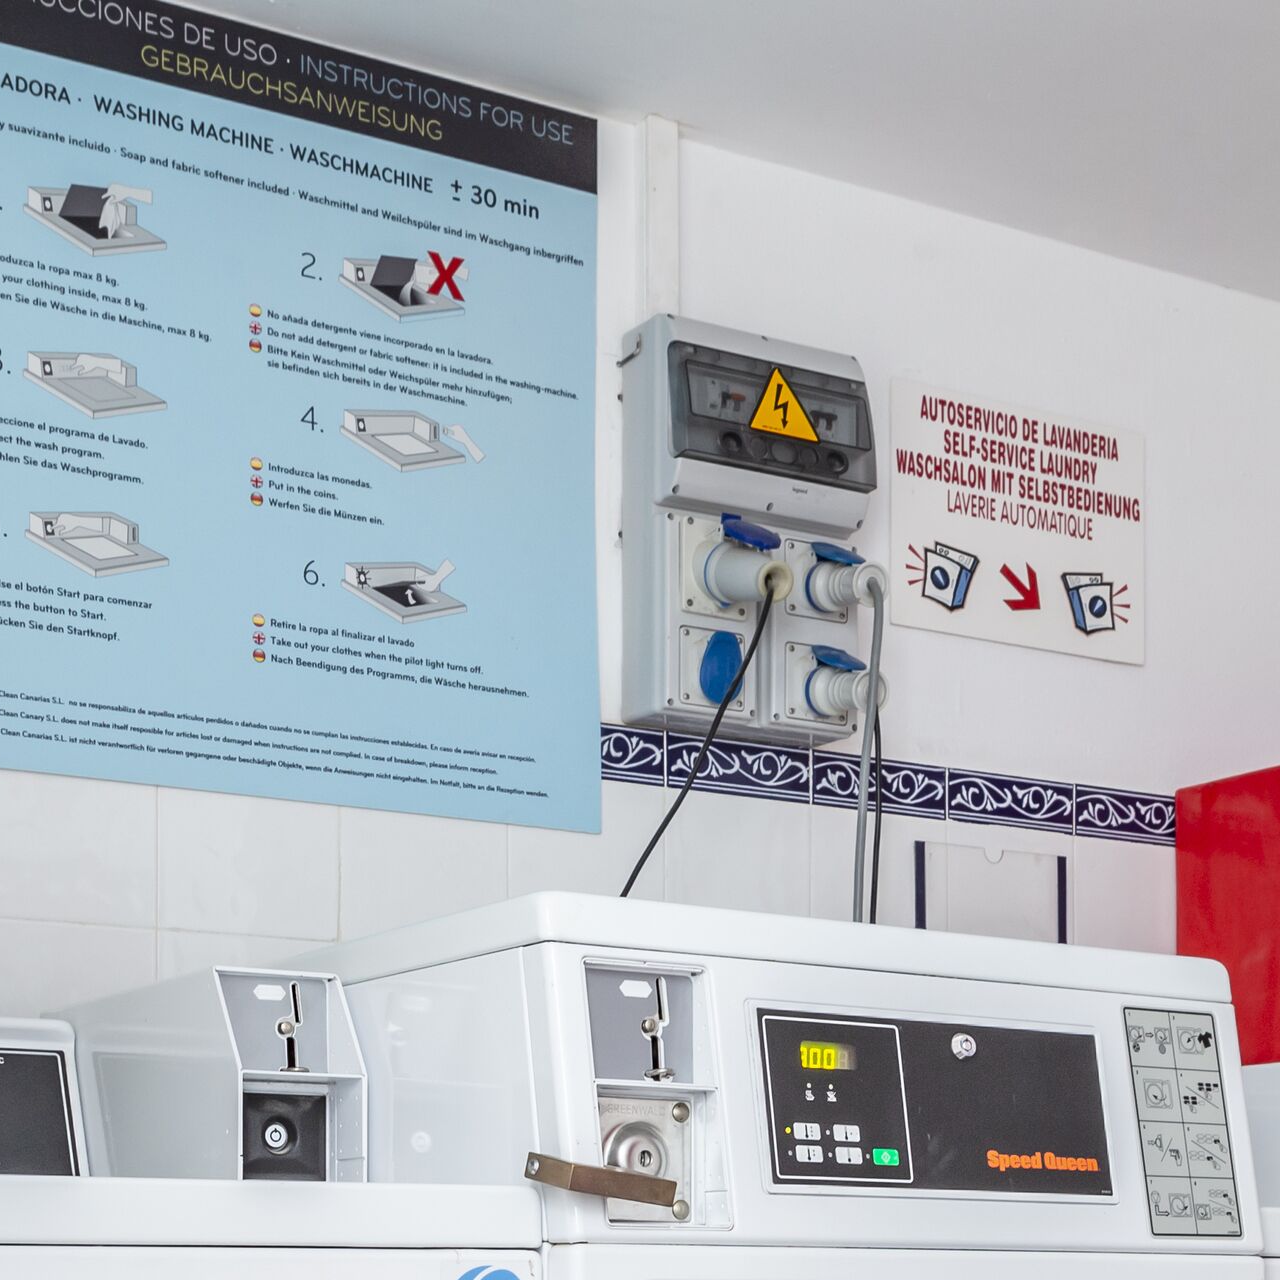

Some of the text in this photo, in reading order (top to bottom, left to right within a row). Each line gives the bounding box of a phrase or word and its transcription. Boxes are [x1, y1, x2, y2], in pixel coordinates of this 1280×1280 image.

[32, 0, 573, 145] CCIONES DE USO INSTRUCTIONS FOR USE
[141, 45, 442, 140] GEBRAUCHSANWEISUNG
[93, 94, 184, 131] WASHING
[190, 119, 273, 154] MACHINE
[289, 143, 433, 193] WASCHMACHINE
[470, 185, 497, 208] 30
[504, 198, 539, 219] min
[37, 260, 46, 270] la
[48, 265, 70, 276] ropa
[73, 270, 93, 280] max
[96, 272, 102, 282] 8
[105, 275, 119, 287] kg.
[301, 252, 322, 281] 2.
[300, 406, 324, 433] 4.
[920, 395, 1119, 461] AUTOSERVICIO DE LAVANDERIA
[37, 422, 46, 431] el
[48, 425, 95, 439] programa
[97, 432, 109, 442] de
[112, 434, 148, 448] Lavado.
[23, 455, 38, 466] Sie
[40, 459, 58, 470] das
[60, 461, 144, 484] Waschprogramm.
[944, 432, 1097, 485] SELF-SERVICE LAUNDRY
[268, 462, 372, 488] Introduzca las monedas.
[268, 479, 338, 500] Put in the coins.
[896, 448, 1140, 522] WASCHSALON MIT SELBSTBEDIENUNG
[947, 489, 1093, 541] LAVERIE AUTOMATIQUE
[303, 560, 325, 587] 6.
[270, 618, 415, 647] Retire la ropa al finalizar el lavado
[986, 1149, 1099, 1172] Speed Queen
